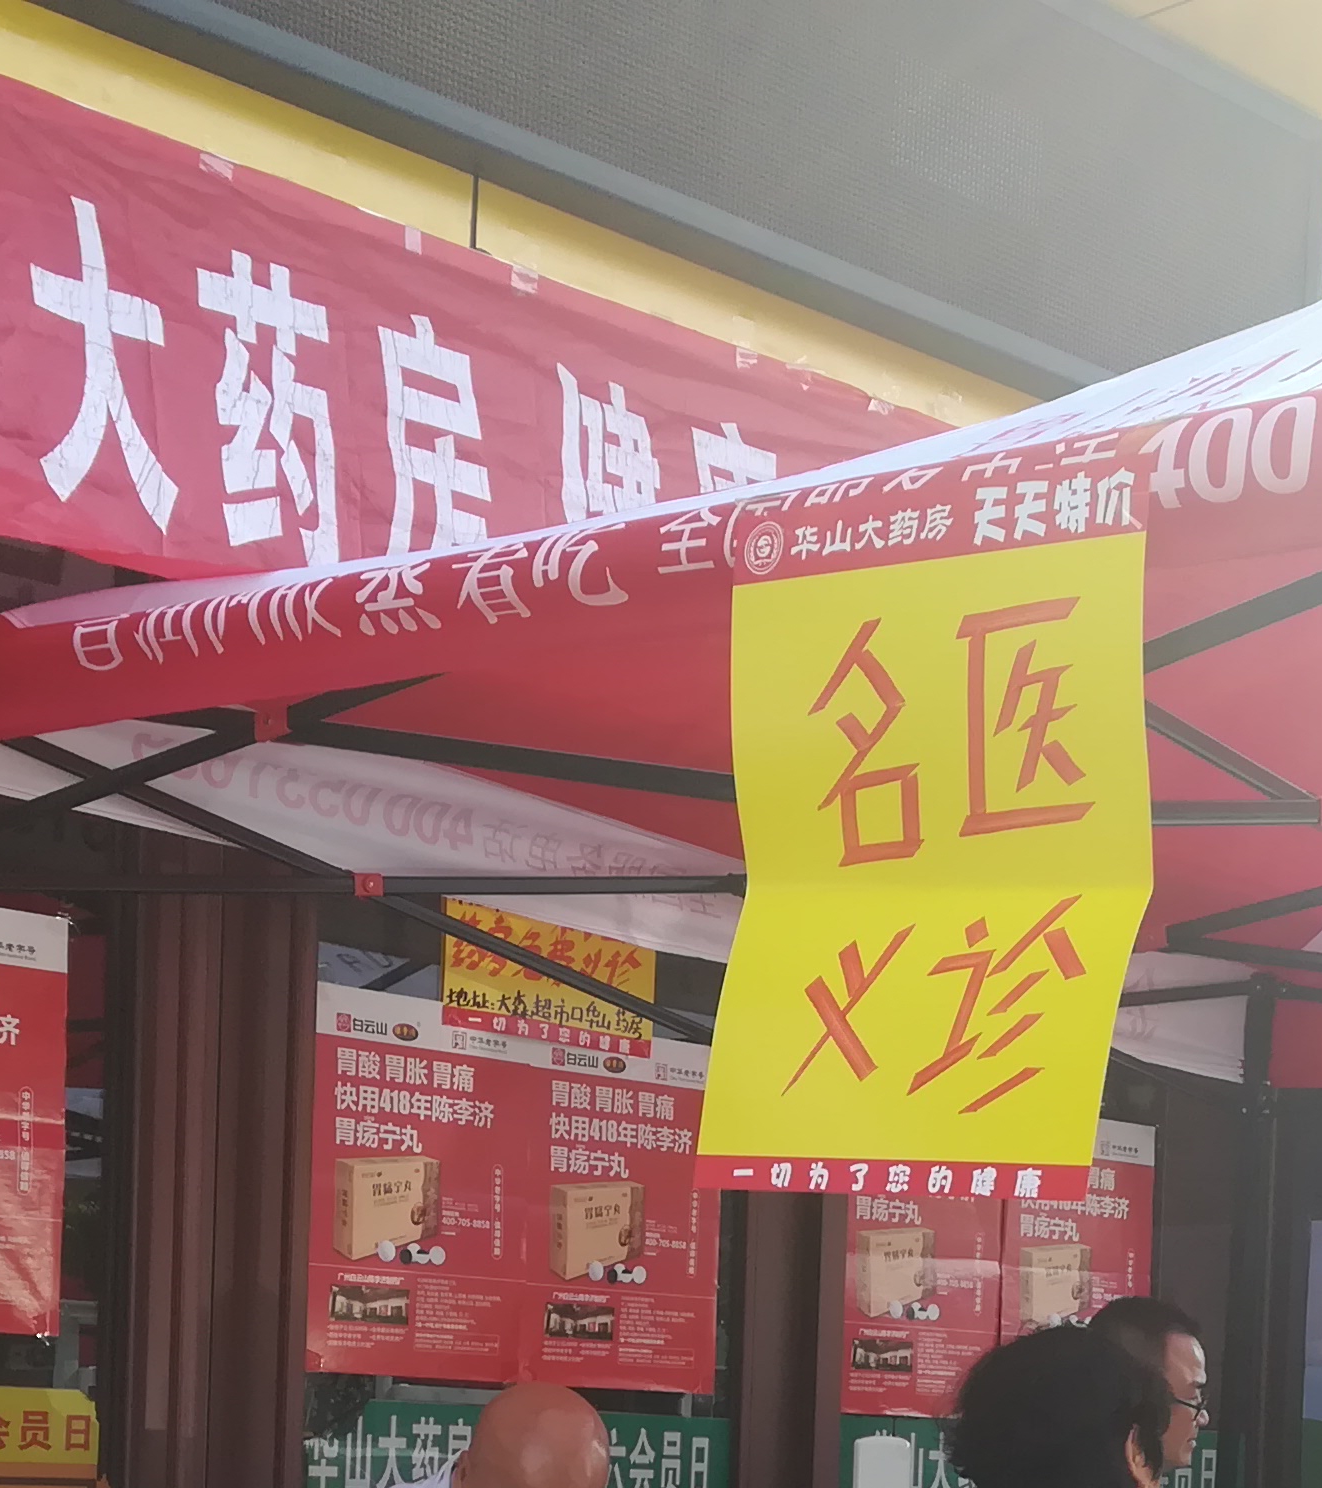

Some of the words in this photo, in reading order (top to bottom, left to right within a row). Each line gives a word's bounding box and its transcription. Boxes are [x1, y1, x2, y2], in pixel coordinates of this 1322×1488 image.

[1142, 395, 1316, 510] 400
[791, 504, 954, 562] 华山大药房
[975, 466, 1136, 546] 天天特价
[807, 595, 1097, 868] 名医
[781, 893, 1088, 1115] 义诊
[336, 1046, 381, 1081] 胃酸
[384, 1053, 429, 1086] 胃胀
[432, 1060, 476, 1093] 胃痛
[334, 1080, 495, 1129] 快用418年陈李济
[551, 1079, 592, 1111] 胃酸
[595, 1085, 634, 1115] 胃胀
[638, 1091, 675, 1121] 胃痛
[334, 1116, 423, 1154] 胃疡宁丸
[549, 1111, 694, 1155] 快用418年陈李济
[549, 1145, 630, 1179] 胃疡宁丸
[732, 1160, 1044, 1200] 一切为了您的健康
[856, 1194, 922, 1225] 胃疡宁丸
[1020, 1213, 1080, 1242] 胃疡宁丸
